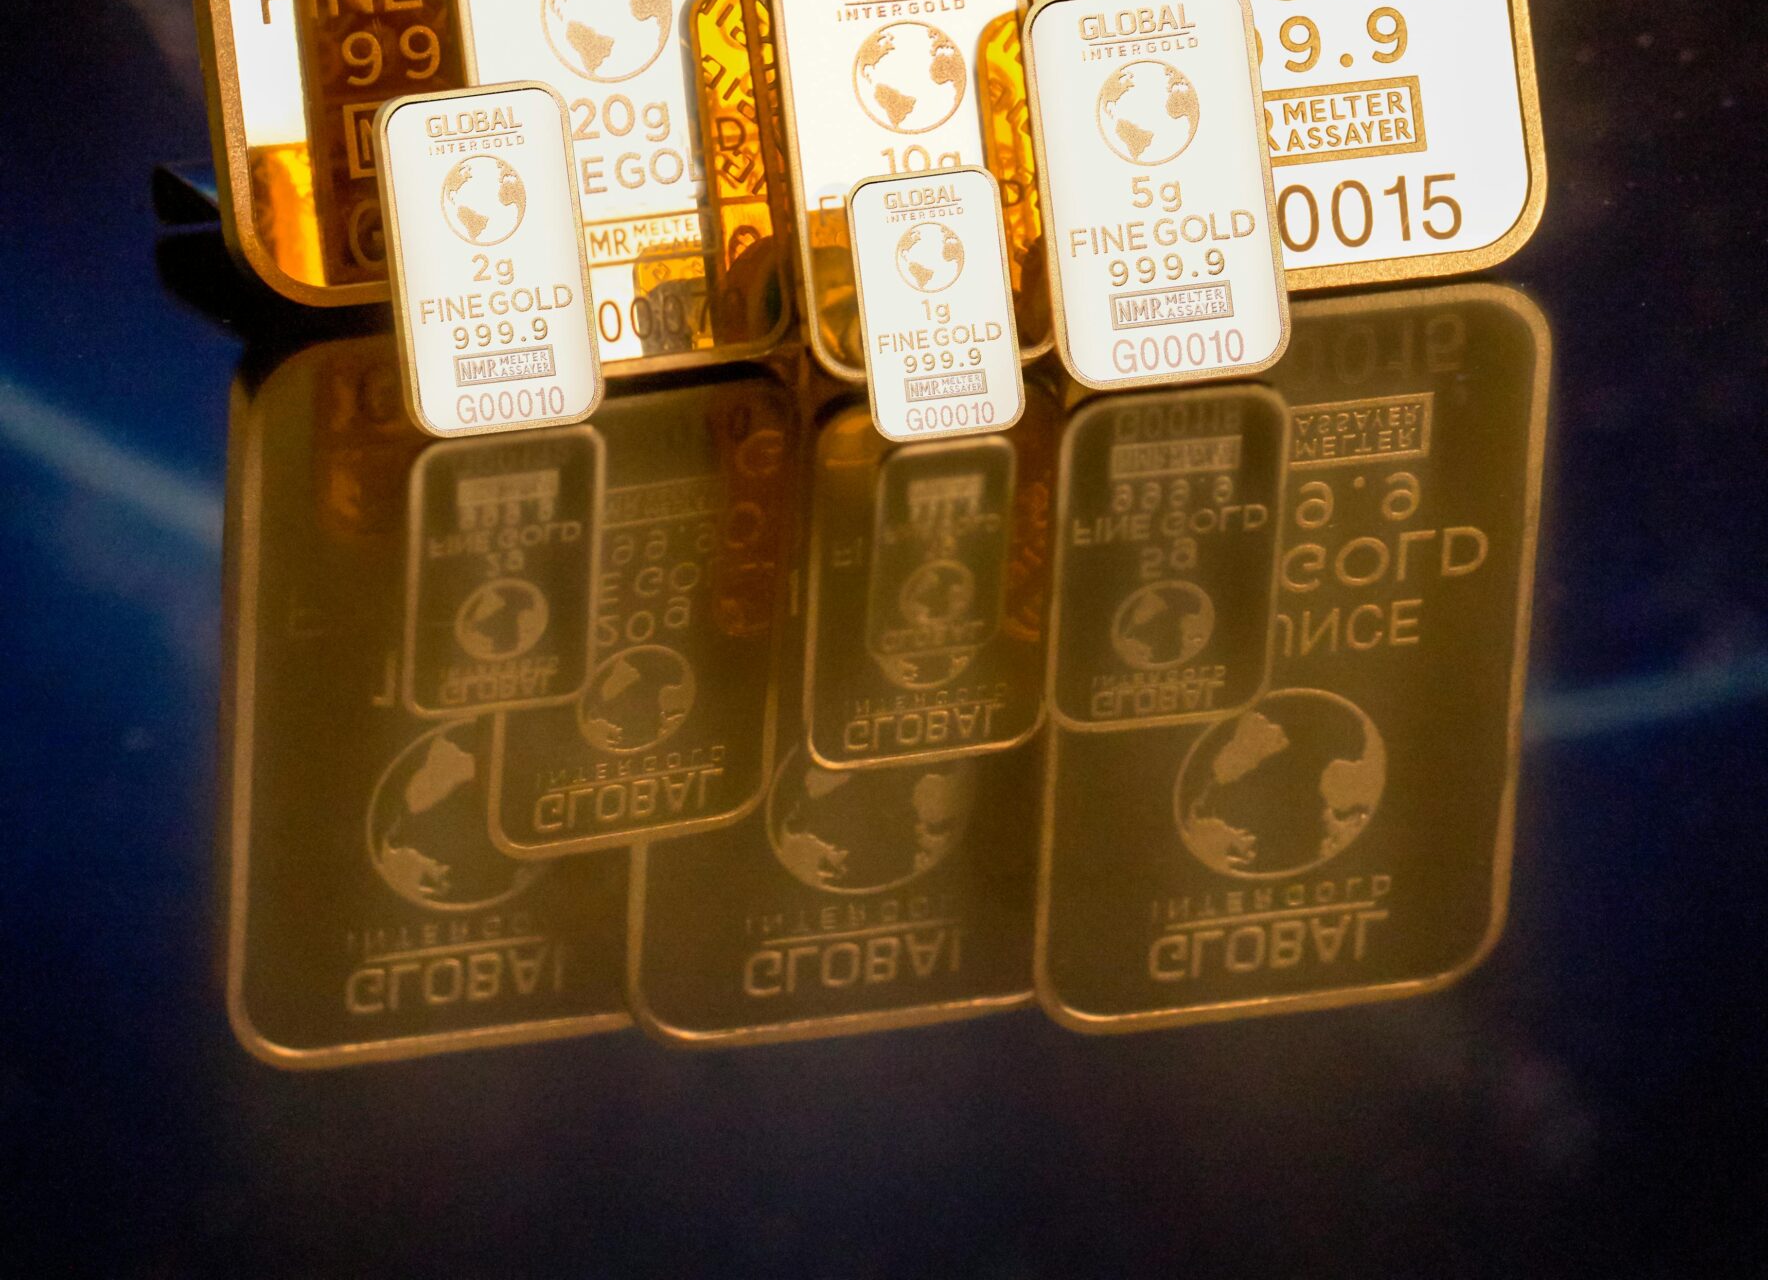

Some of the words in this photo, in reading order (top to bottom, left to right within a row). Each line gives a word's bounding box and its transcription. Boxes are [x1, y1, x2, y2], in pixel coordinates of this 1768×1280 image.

[1078, 3, 1196, 41] GLOBAL
[1081, 37, 1199, 62] INTERGOLD
[1254, 6, 1409, 73] 9.9
[425, 106, 523, 139] GLOBAL
[570, 93, 671, 143] 20g
[1283, 91, 1408, 125] MELTER
[428, 134, 526, 156] INTERGOLD
[1286, 117, 1414, 153] ASSAYER
[883, 184, 963, 211] GLOBAL
[1131, 175, 1183, 213] 5g
[886, 207, 965, 224] INTERGOLD
[1277, 172, 1463, 253] 0015
[1069, 220, 1148, 258] FINE
[1152, 209, 1256, 247] GOLD
[472, 253, 515, 286] 2g
[1108, 247, 1226, 287] 999.9
[419, 293, 485, 325] FINE
[488, 283, 574, 316] GOLD
[921, 299, 952, 325] 1g
[1118, 296, 1164, 323] NMR
[1164, 287, 1225, 306] MELTER
[1167, 300, 1228, 320] ASSAYER
[453, 316, 549, 350] 999.9
[877, 328, 931, 354] FINE
[932, 322, 1003, 348] GOLD
[499, 351, 549, 367] MELTER
[904, 347, 983, 374] 999.9
[1112, 328, 1245, 374] G00010
[460, 358, 501, 381] NMR
[501, 363, 551, 378] ASSAYER
[941, 373, 982, 386] MELTER
[456, 385, 565, 425] G00010
[909, 380, 942, 398] NMR
[942, 384, 984, 395] ASSAYER
[906, 400, 996, 432] G00010
